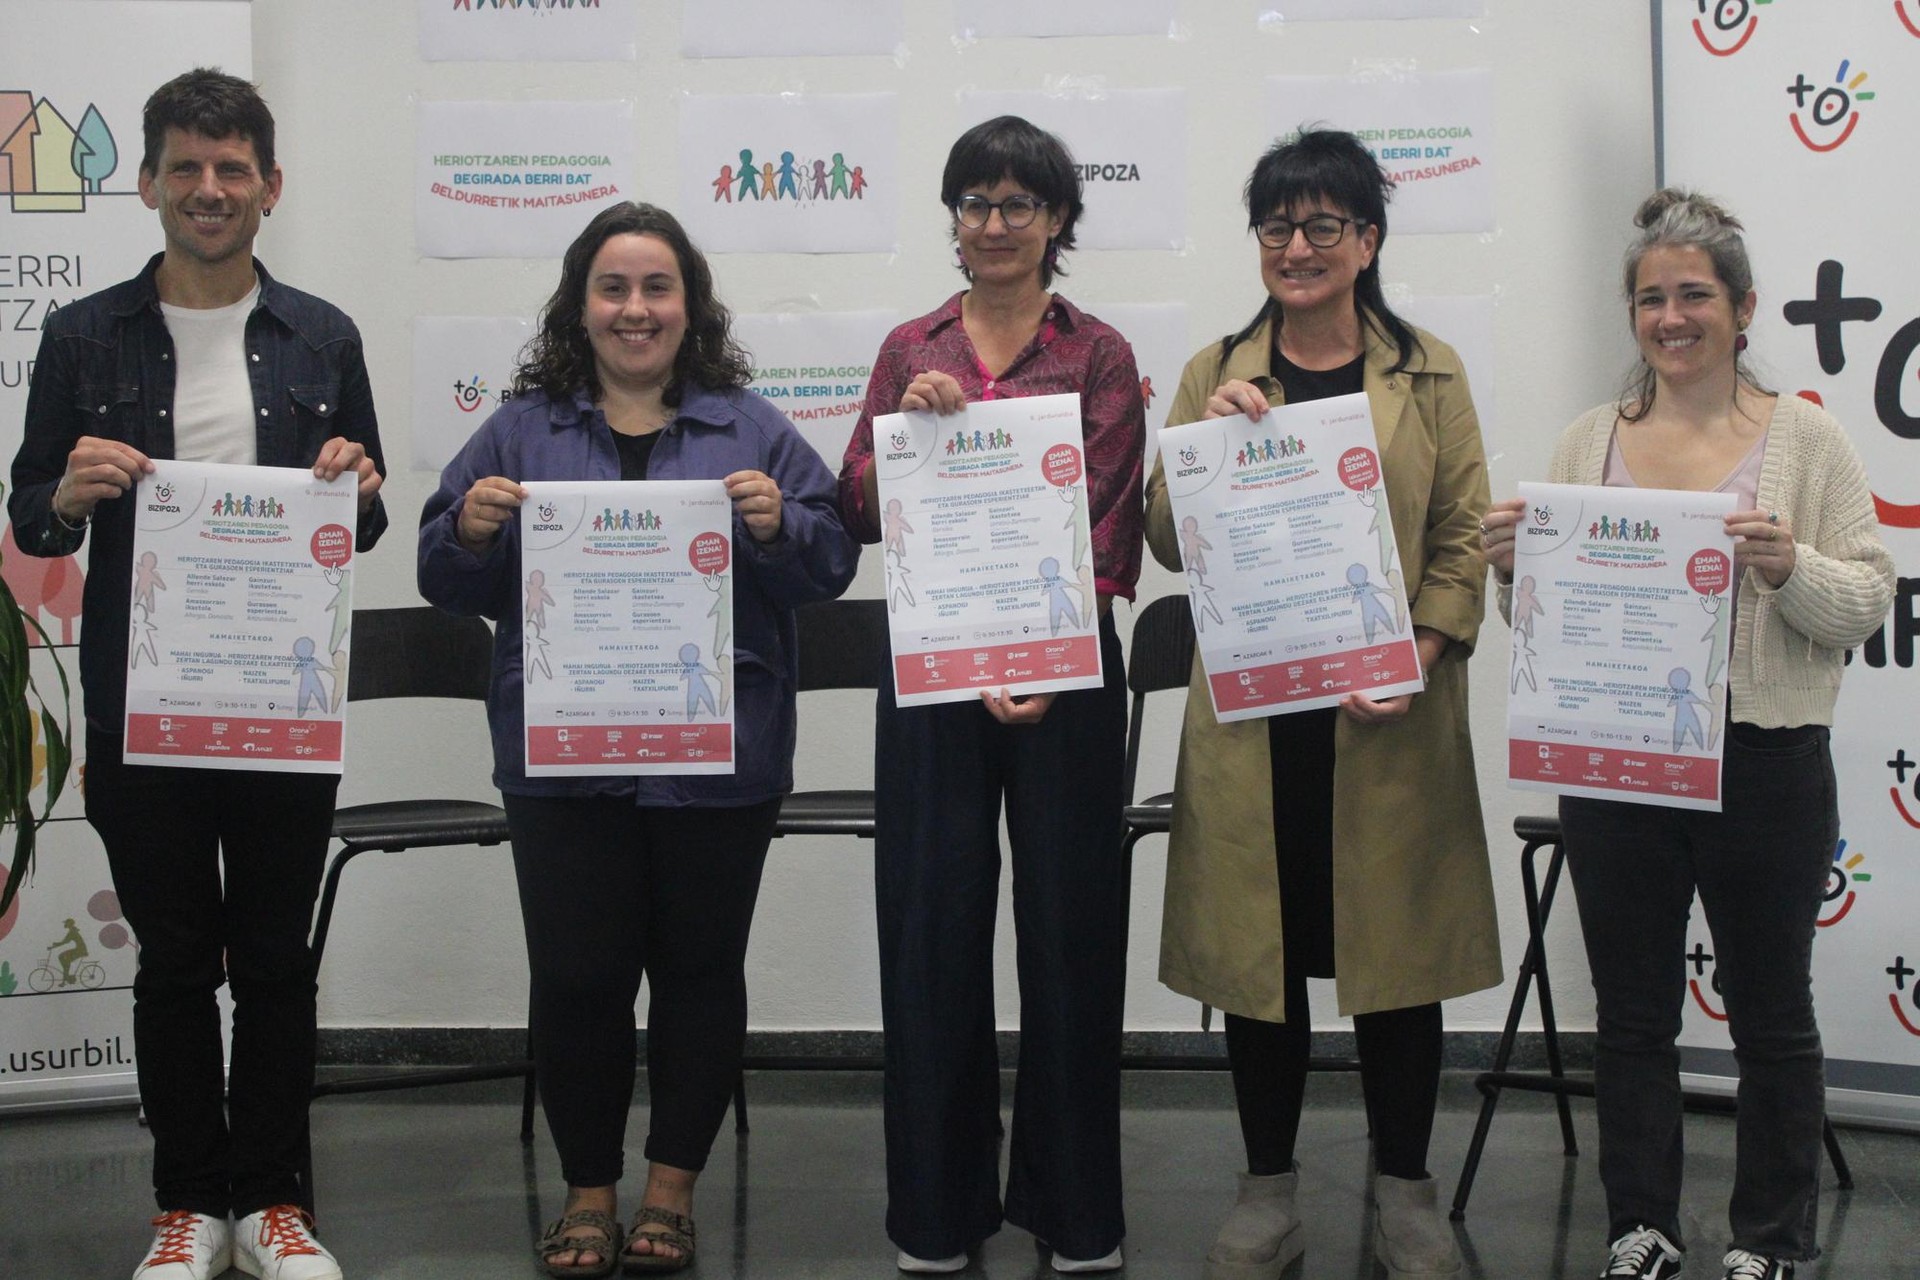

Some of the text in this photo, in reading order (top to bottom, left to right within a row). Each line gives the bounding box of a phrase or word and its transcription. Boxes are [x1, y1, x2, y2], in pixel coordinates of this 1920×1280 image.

[1389, 127, 1472, 140] PEDAGOGIA
[1382, 148, 1421, 160] BERRI
[1425, 146, 1453, 158] BAT
[434, 155, 612, 167] HERIOTZAREN PEDAGOGIA
[454, 173, 592, 185] BEGIRADA BERRI BAT
[430, 182, 619, 208] BELDURRETIK MAITASUNERA
[801, 366, 870, 378] PEDAGOGI
[794, 385, 832, 397] BERRI
[836, 384, 861, 396] BAT
[792, 401, 866, 421] MAITASUN
[887, 451, 916, 461] BIZIPOZA
[1176, 465, 1207, 477] BIZIPOZA
[148, 504, 180, 512] BIZIPOZA
[532, 523, 562, 531] BIZIPOZA
[1527, 527, 1558, 535] BIZIPOZA
[319, 530, 342, 538] EMAN
[696, 537, 719, 547] EMAN
[1695, 555, 1719, 564] EMAN
